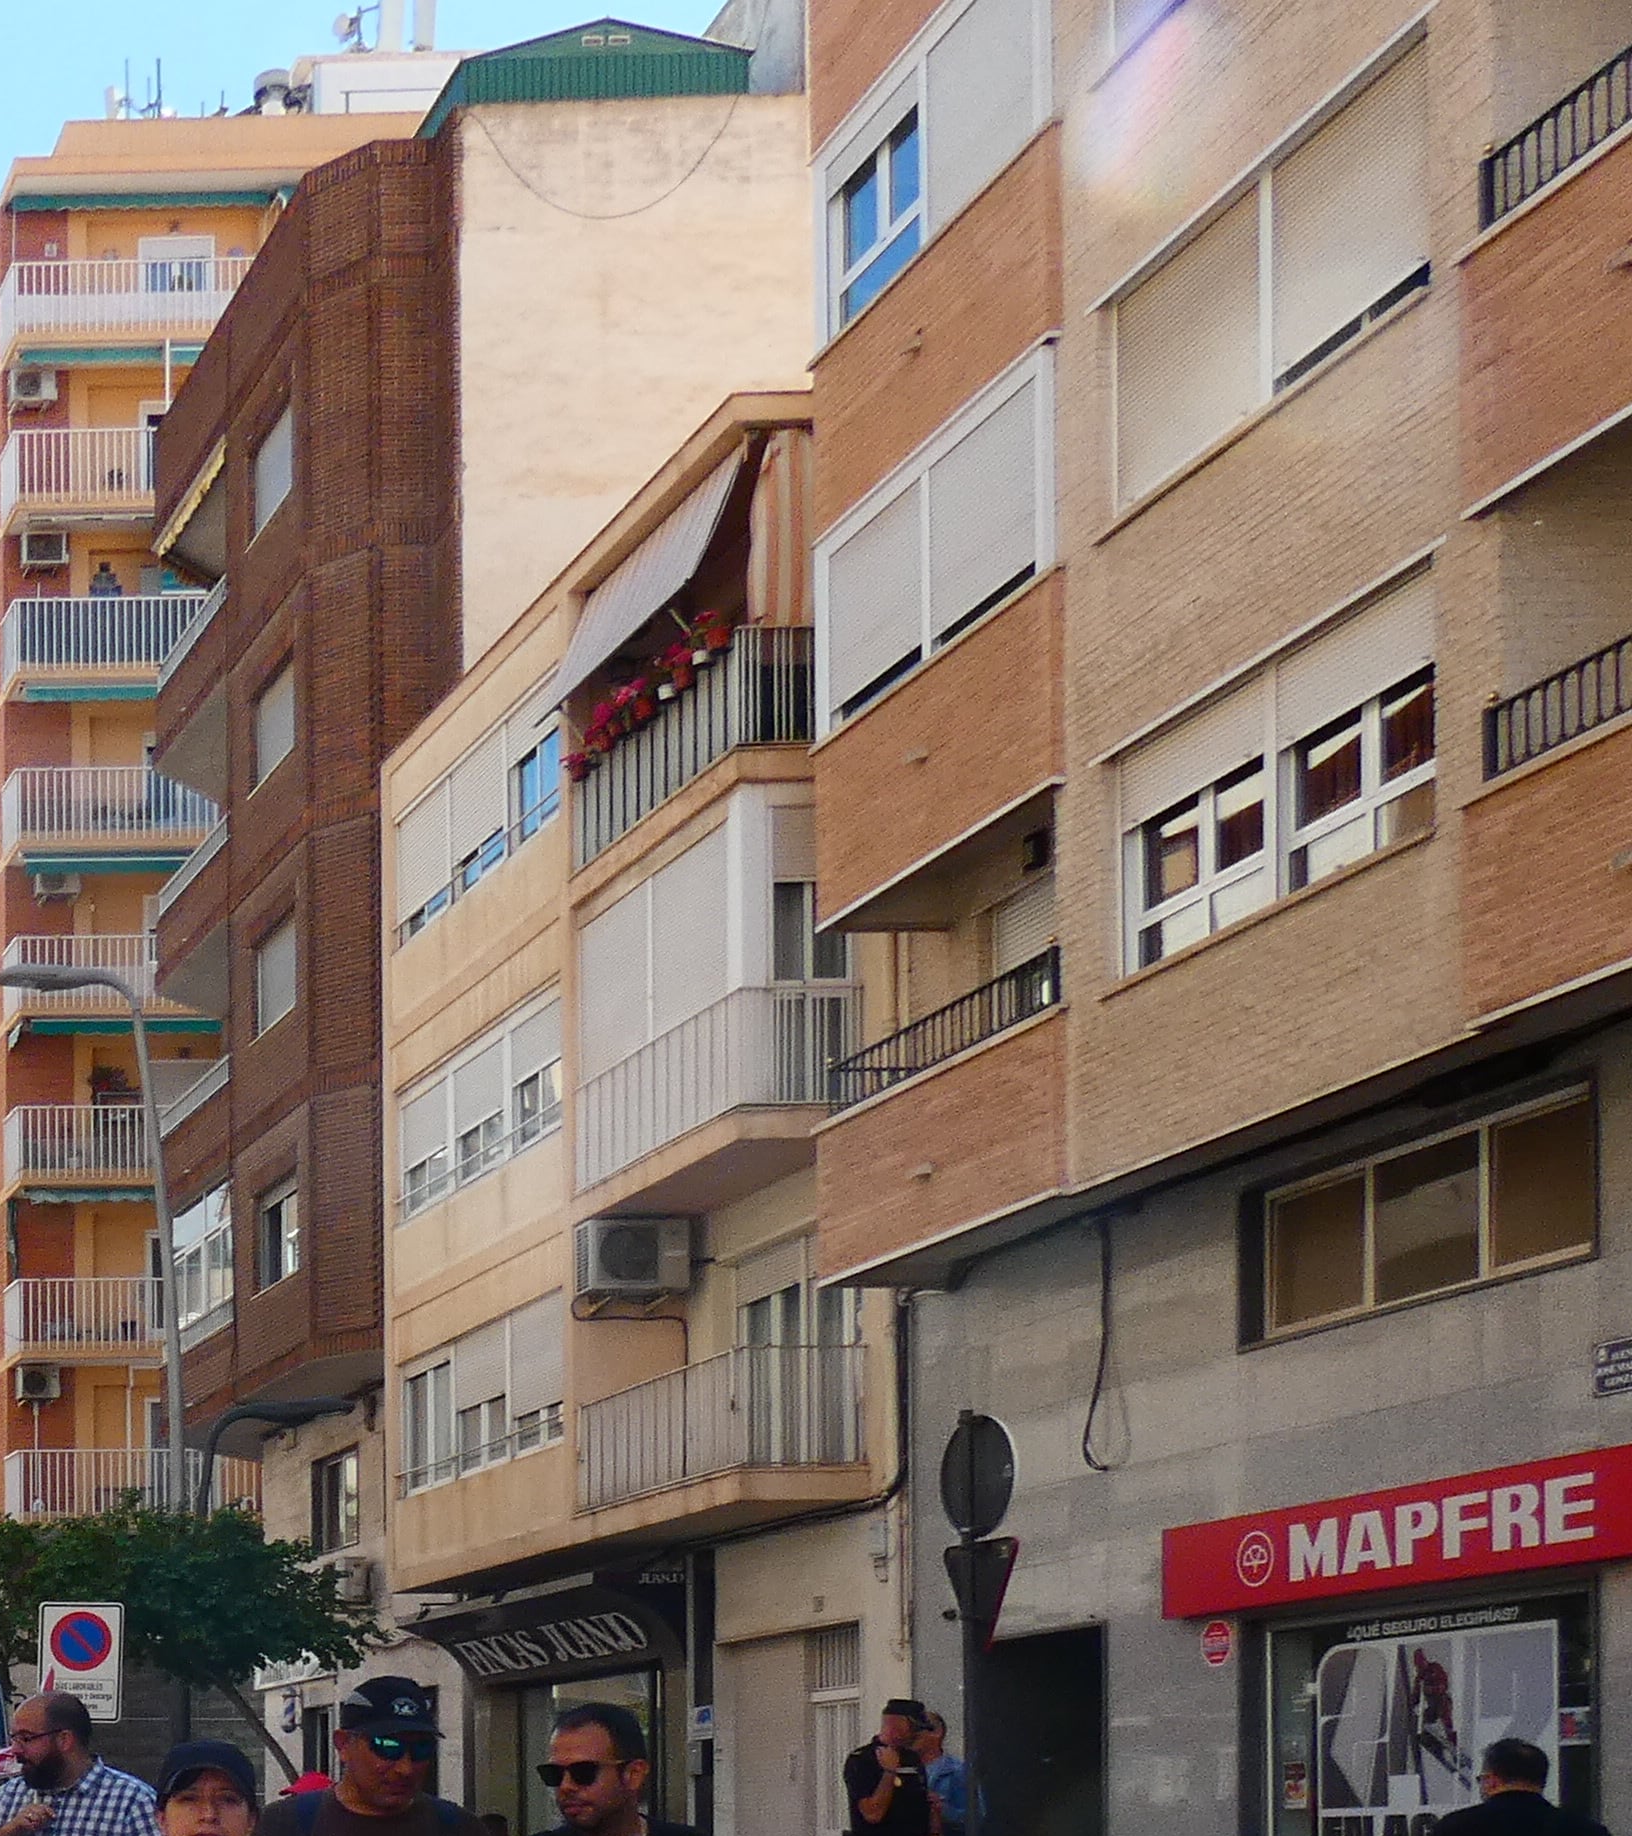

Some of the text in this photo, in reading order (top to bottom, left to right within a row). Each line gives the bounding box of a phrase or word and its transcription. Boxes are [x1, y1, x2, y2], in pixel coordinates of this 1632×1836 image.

[1288, 1471, 1595, 1583] MAPFRE
[454, 1611, 649, 1677] FINCAS JUANJO
[1383, 1615, 1437, 1636] SEGURO
